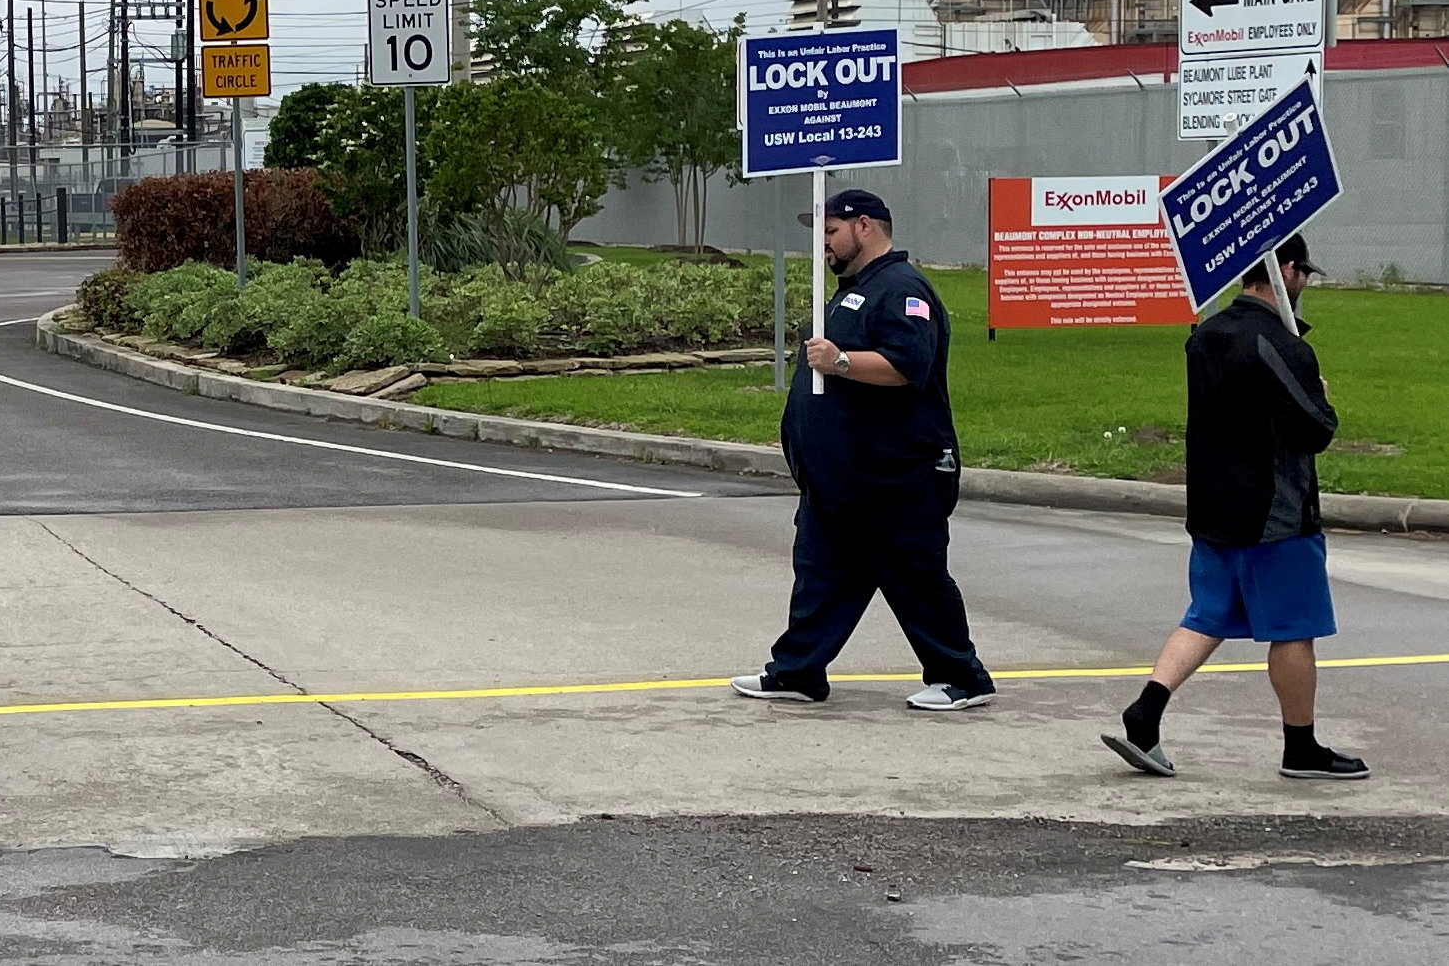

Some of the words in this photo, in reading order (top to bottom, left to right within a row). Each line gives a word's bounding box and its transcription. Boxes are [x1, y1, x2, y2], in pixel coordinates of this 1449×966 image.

[383, 13, 434, 29] LIMIT
[1187, 28, 1244, 47] ExxonMobil
[1248, 23, 1294, 40] EMPLOYEES
[1297, 21, 1317, 36] ONLY
[386, 34, 433, 71] 10
[757, 49, 775, 58] This
[799, 46, 825, 55] Unfair
[826, 45, 850, 54] Labor
[851, 42, 886, 52] Practice
[211, 53, 261, 69] TRAFFIC
[215, 74, 257, 88] CIRCLE
[749, 60, 828, 91] LOCK
[835, 56, 896, 84] OUT
[1183, 67, 1225, 83] BEAUMONT
[1227, 65, 1247, 81] LUBE
[1249, 64, 1273, 79] PLANT
[817, 89, 828, 99] By
[1183, 90, 1225, 106] SYCAMORE
[1227, 88, 1256, 104] STREET
[768, 104, 798, 114] EXXON
[799, 102, 827, 112] MOBIL
[829, 98, 877, 109] BEAUMONT
[803, 113, 841, 124] AGAINST
[1182, 114, 1220, 130] BLENDING
[764, 131, 795, 146] USW
[798, 128, 834, 143] Local
[838, 125, 881, 139] 13-243
[1176, 188, 1195, 204] This
[1217, 148, 1242, 171] Unfair
[1243, 129, 1267, 151] Labor
[1267, 101, 1301, 130] Practice
[1172, 157, 1255, 238] LOCK
[1257, 104, 1314, 167] OUT
[1246, 183, 1257, 195] By
[1045, 190, 1146, 212] ExxonMobil
[1202, 216, 1232, 244] EXXON
[1232, 195, 1260, 219] MOBIL
[1260, 155, 1306, 197] BEAUMONT
[1240, 194, 1276, 227] AGAINST
[1205, 242, 1234, 272] USW
[1238, 212, 1274, 246] Local
[1276, 176, 1318, 214] 13-243
[994, 230, 1039, 242] BEAUMONT
[1038, 230, 1076, 241] COMPLEX
